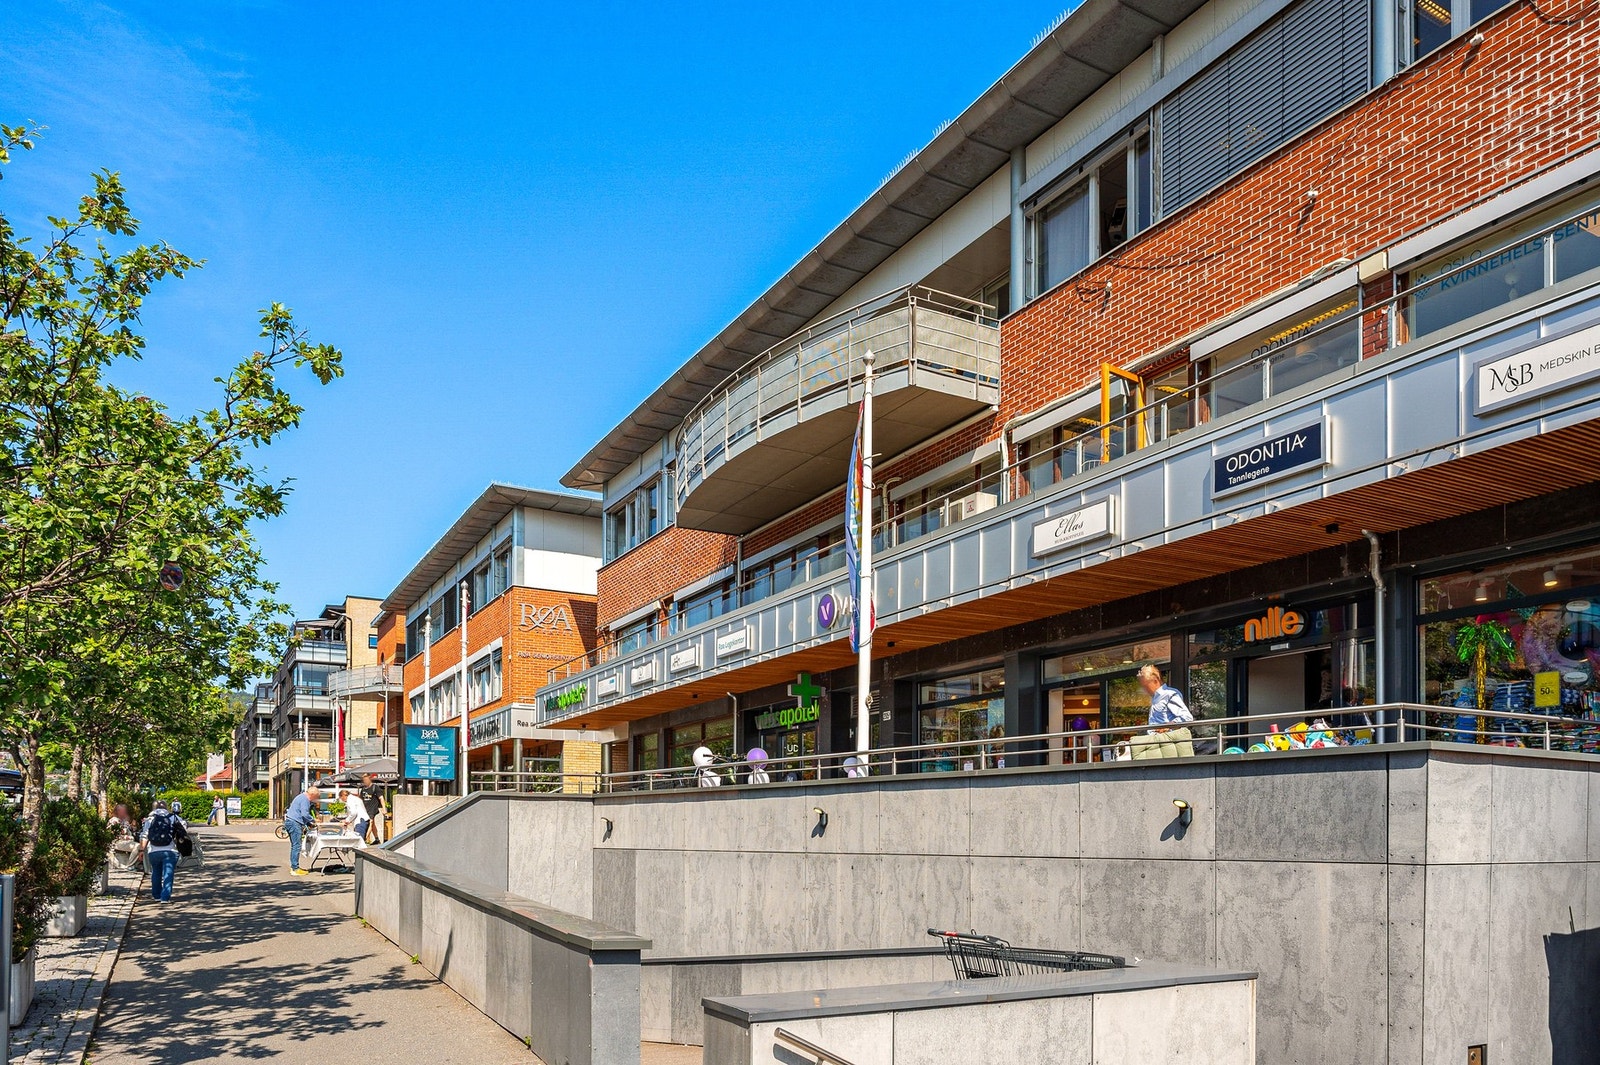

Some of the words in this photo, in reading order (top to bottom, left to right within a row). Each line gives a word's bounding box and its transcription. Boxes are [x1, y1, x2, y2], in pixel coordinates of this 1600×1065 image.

[1539, 347, 1591, 373] MEDSKIN
[1488, 362, 1534, 393] MSB
[1225, 433, 1308, 473] ODONTIA
[1228, 465, 1270, 485] Tannlegene
[1054, 511, 1084, 538] Ellas
[518, 602, 573, 633] RØA
[1244, 606, 1300, 642] nille
